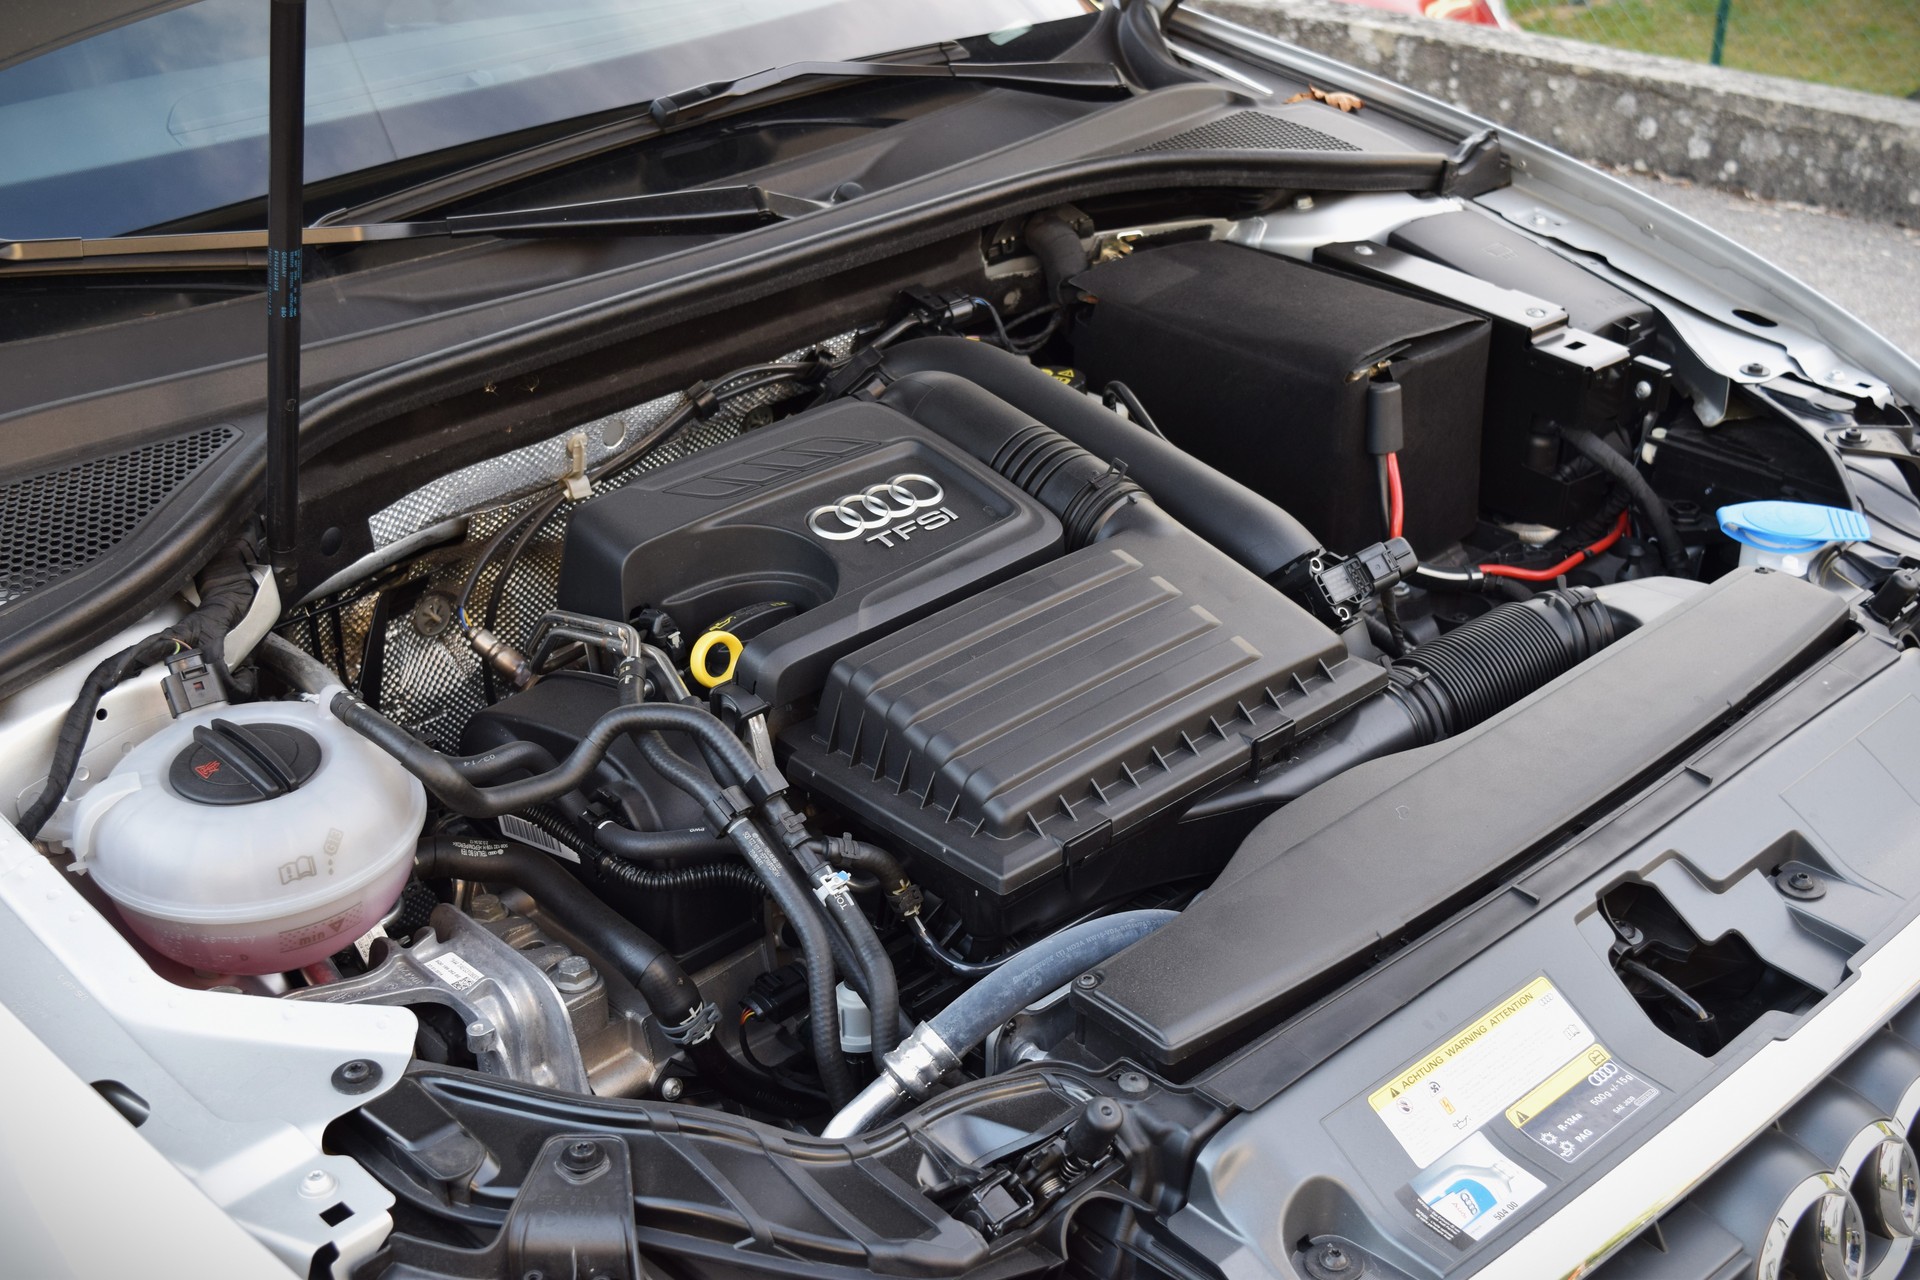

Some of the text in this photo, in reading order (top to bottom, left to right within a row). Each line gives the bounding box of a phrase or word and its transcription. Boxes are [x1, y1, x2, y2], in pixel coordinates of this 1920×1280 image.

[866, 507, 959, 548] TFSI
[201, 934, 256, 945] Germany
[299, 931, 325, 945] min
[1402, 992, 1534, 1089] ACHTUNG WARNING ATTENTION
[1612, 1103, 1625, 1114] SAE
[1574, 1128, 1593, 1143] PAG
[1493, 1201, 1519, 1221] 504 00
